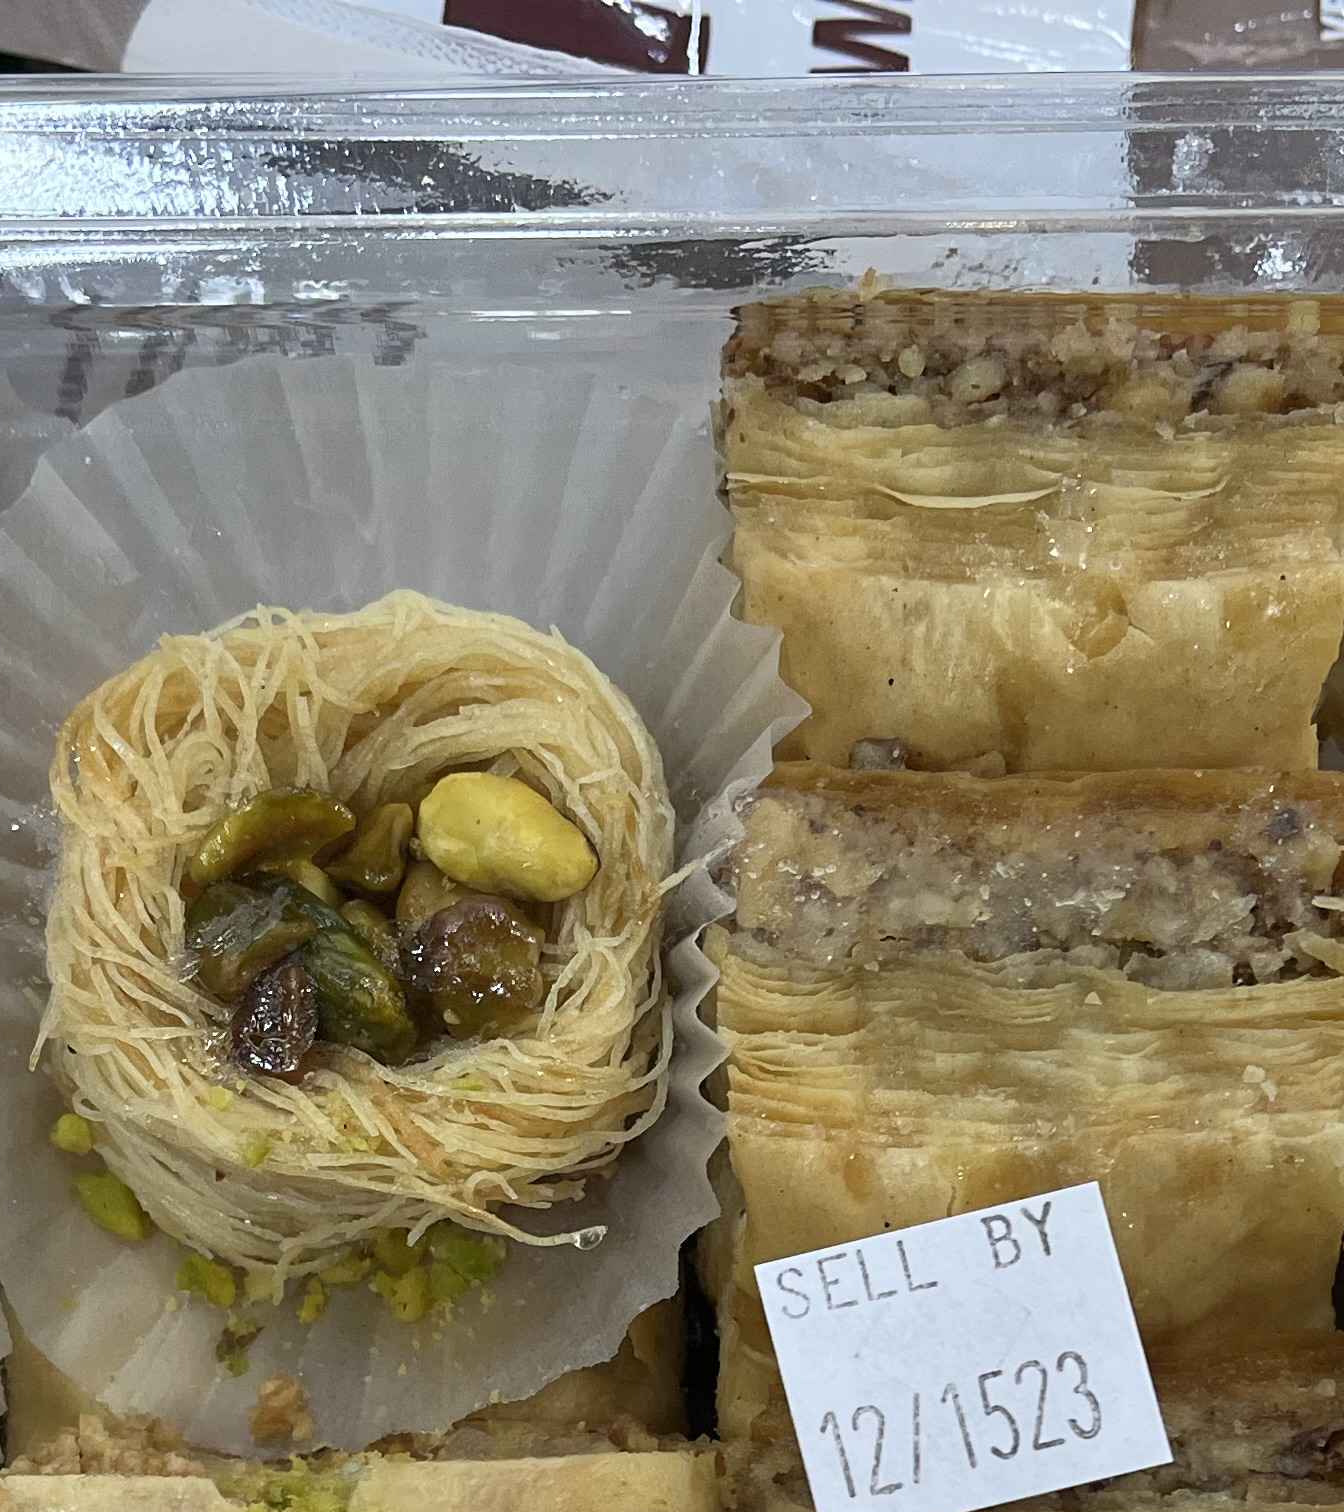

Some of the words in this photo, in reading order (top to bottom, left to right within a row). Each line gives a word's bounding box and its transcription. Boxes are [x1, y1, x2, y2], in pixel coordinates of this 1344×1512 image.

[776, 1240, 938, 1320] SELL
[981, 1200, 1052, 1269] BY
[819, 1350, 1102, 1498] 12/1523
